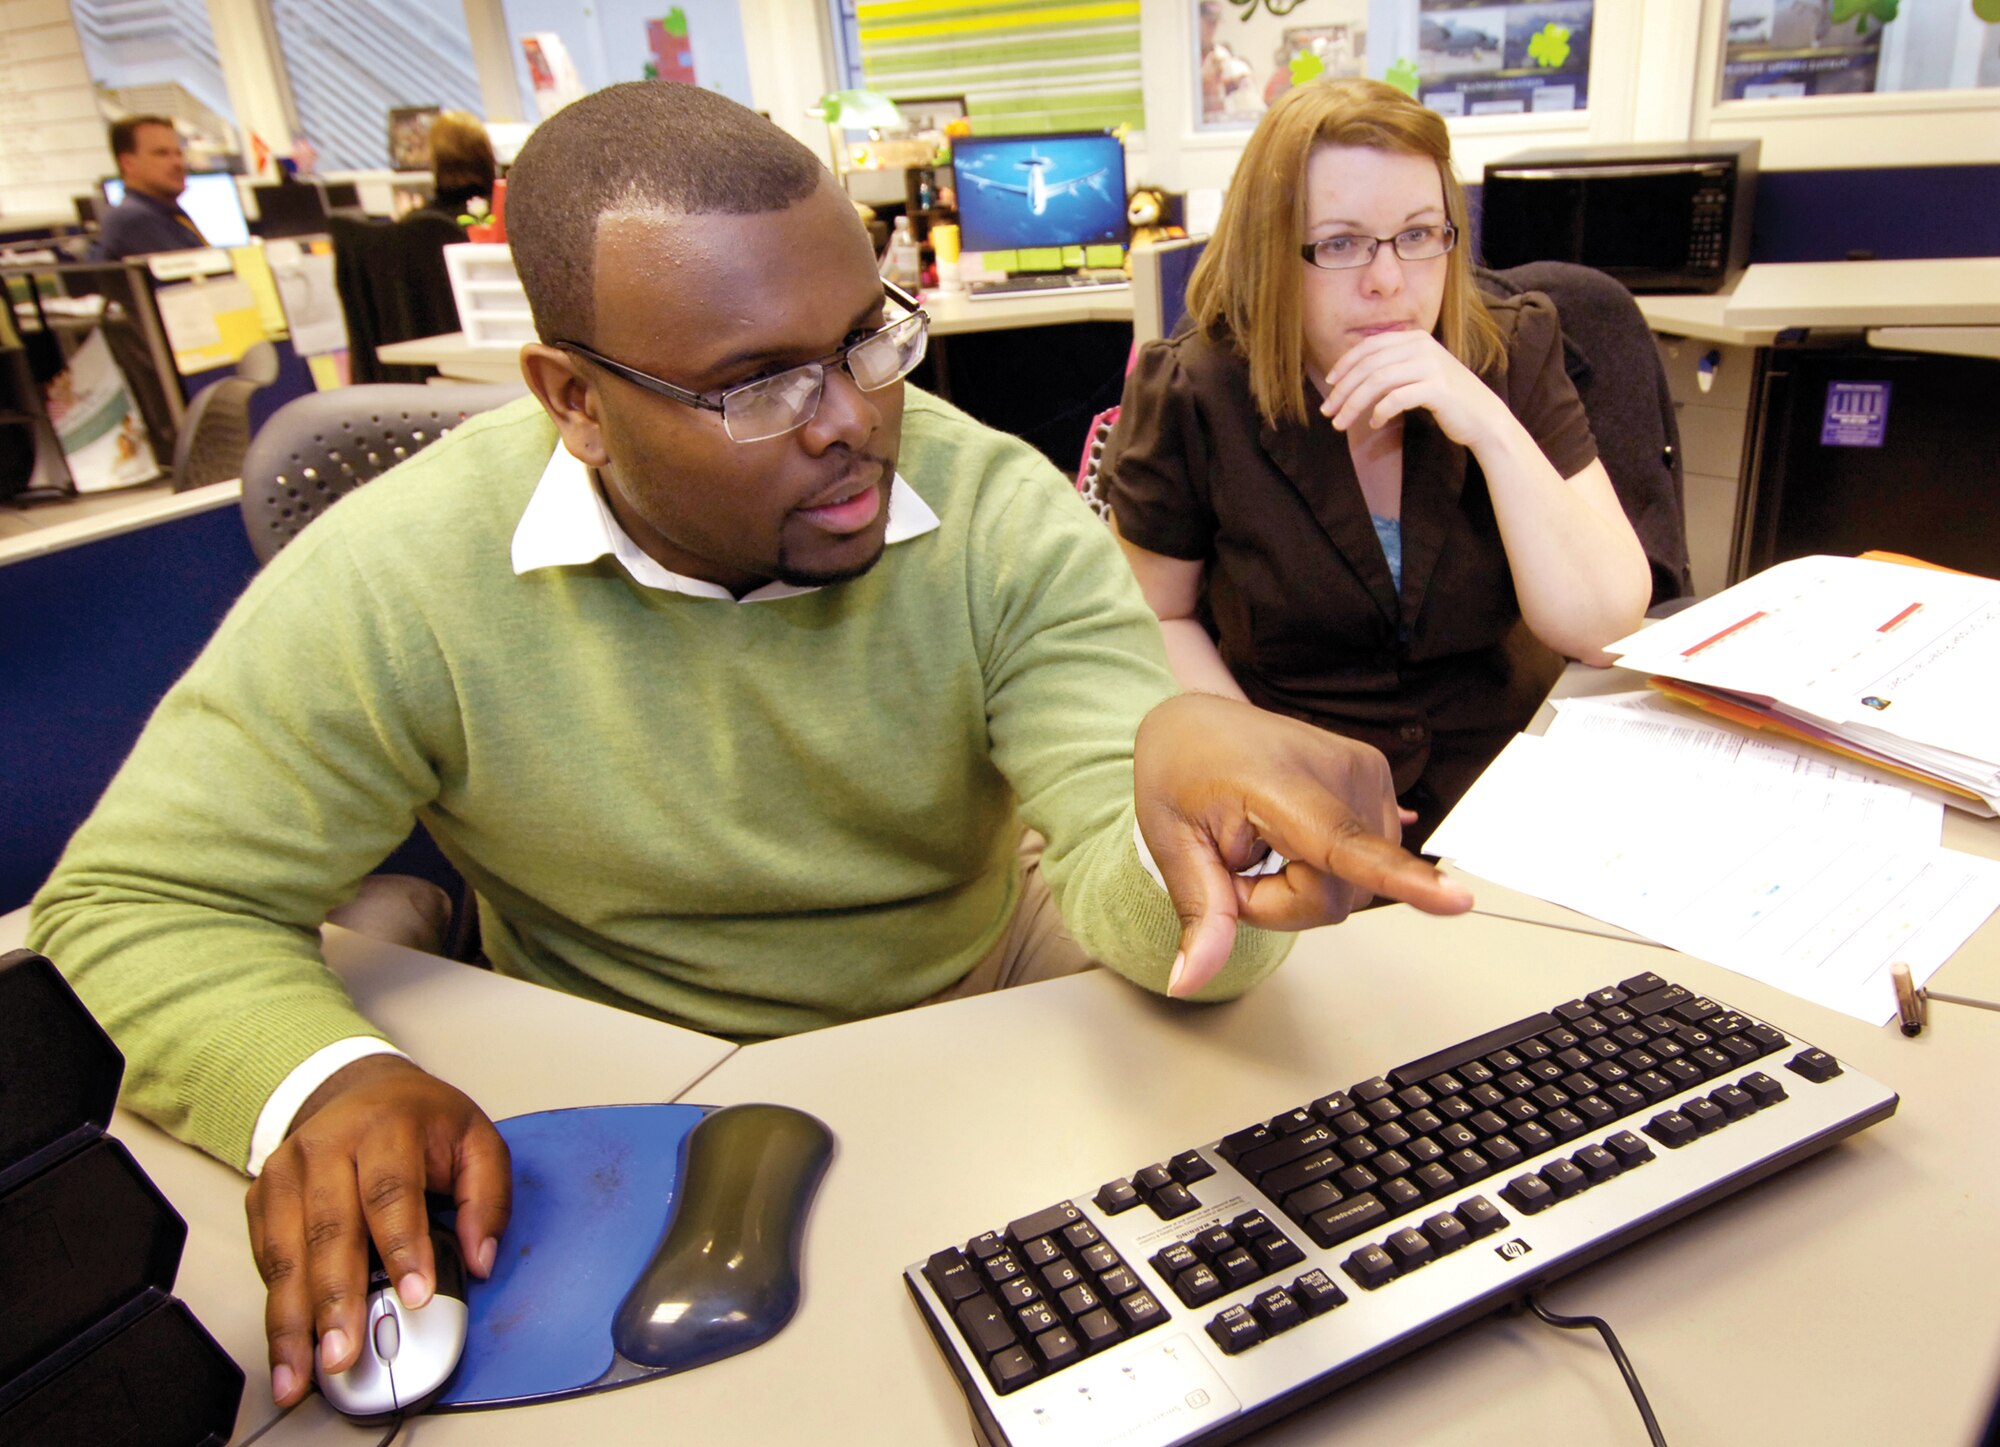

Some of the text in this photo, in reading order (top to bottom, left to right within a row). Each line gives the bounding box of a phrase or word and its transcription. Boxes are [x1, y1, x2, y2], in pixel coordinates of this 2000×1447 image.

[1618, 1011, 1629, 1020] Z
[1590, 1022, 1602, 1031] X
[1563, 1033, 1572, 1042] C
[1632, 1032, 1643, 1040] S
[1693, 1032, 1707, 1041] Q
[1536, 1045, 1547, 1053] V
[1604, 1043, 1616, 1052] D
[1666, 1043, 1681, 1052] W
[1505, 1056, 1517, 1065] B
[1578, 1054, 1588, 1063] F
[1640, 1054, 1652, 1064] E
[1476, 1069, 1488, 1078] N
[1545, 1066, 1558, 1075] G
[1609, 1066, 1622, 1075] R
[1445, 1080, 1459, 1090] M
[1516, 1080, 1529, 1088] H
[1583, 1080, 1594, 1089] T
[1553, 1092, 1565, 1101] Y
[1456, 1103, 1470, 1112] K
[1521, 1104, 1534, 1114] U
[1425, 1115, 1438, 1123] L
[1458, 1132, 1470, 1141] O
[1430, 1144, 1439, 1154] P
[1066, 1209, 1077, 1219] 0
[1327, 1204, 1364, 1223] Backspace
[1242, 1215, 1265, 1229] Delete
[1176, 1223, 1210, 1239] WARNING
[1212, 1231, 1228, 1243] End
[1267, 1238, 1289, 1251] Insert
[1165, 1245, 1188, 1259] Down
[1172, 1250, 1193, 1263] Page
[1103, 1253, 1113, 1263] 4
[1227, 1254, 1250, 1268] Home
[1005, 1262, 1016, 1273] 3
[1062, 1269, 1074, 1280] 5
[1102, 1268, 1126, 1281] Home
[1195, 1268, 1209, 1280] Up
[1123, 1276, 1134, 1287] 7
[1194, 1273, 1214, 1287] Page
[1311, 1276, 1329, 1288] Scrn
[1021, 1286, 1033, 1297] 6
[1318, 1282, 1335, 1294] Print
[1082, 1293, 1093, 1304] 8
[1266, 1290, 1286, 1303] Lock
[1128, 1295, 1150, 1309] Lock
[1269, 1297, 1292, 1312] Scroll
[1135, 1301, 1155, 1314] Num
[1220, 1304, 1245, 1320] Break
[1040, 1312, 1051, 1323] 9
[1231, 1318, 1256, 1334] Pause
